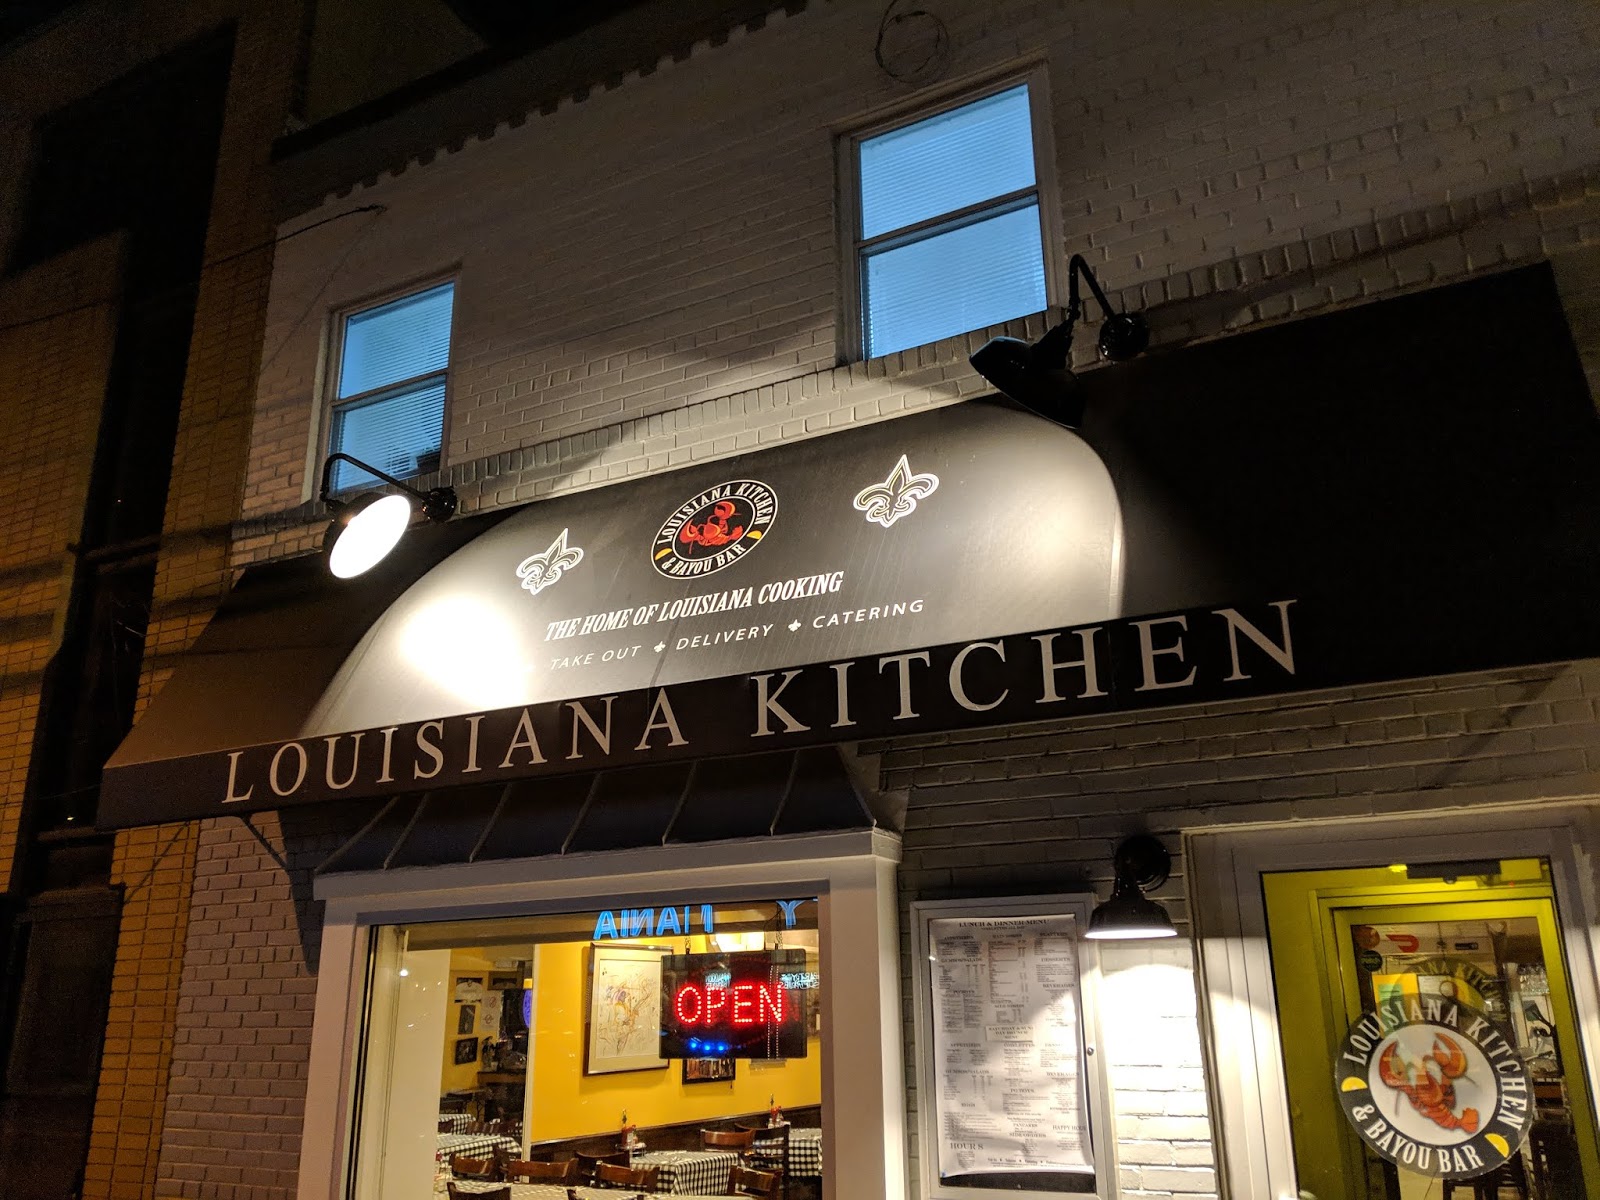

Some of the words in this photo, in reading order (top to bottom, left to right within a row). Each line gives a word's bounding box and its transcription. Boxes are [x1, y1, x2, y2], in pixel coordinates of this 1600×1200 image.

[656, 485, 734, 545] LOUISIANA
[735, 481, 773, 527] KITCHEN
[661, 555, 674, 570] &
[670, 555, 714, 577] BAYOU
[715, 543, 748, 567] BAR
[544, 619, 580, 642] THE
[577, 608, 630, 636] HOME
[632, 606, 655, 626] OF
[656, 587, 755, 623] LOUISIANA
[758, 570, 845, 606] COOKING
[550, 650, 594, 670] TAKE
[601, 644, 642, 662] OUT
[676, 623, 775, 651] DELIVERY
[812, 599, 925, 629] CATERING
[221, 686, 689, 804] LOUISIANA
[750, 599, 1298, 738] KITCHEN
[677, 984, 783, 1024] OPEN
[1342, 999, 1459, 1067] LOUISIANA
[1466, 1016, 1528, 1131] KITCHEN
[950, 1142, 984, 1150] HOURS
[1351, 1104, 1375, 1122] &
[1363, 1118, 1431, 1171] BAYOU
[1438, 1143, 1484, 1174] BAR
